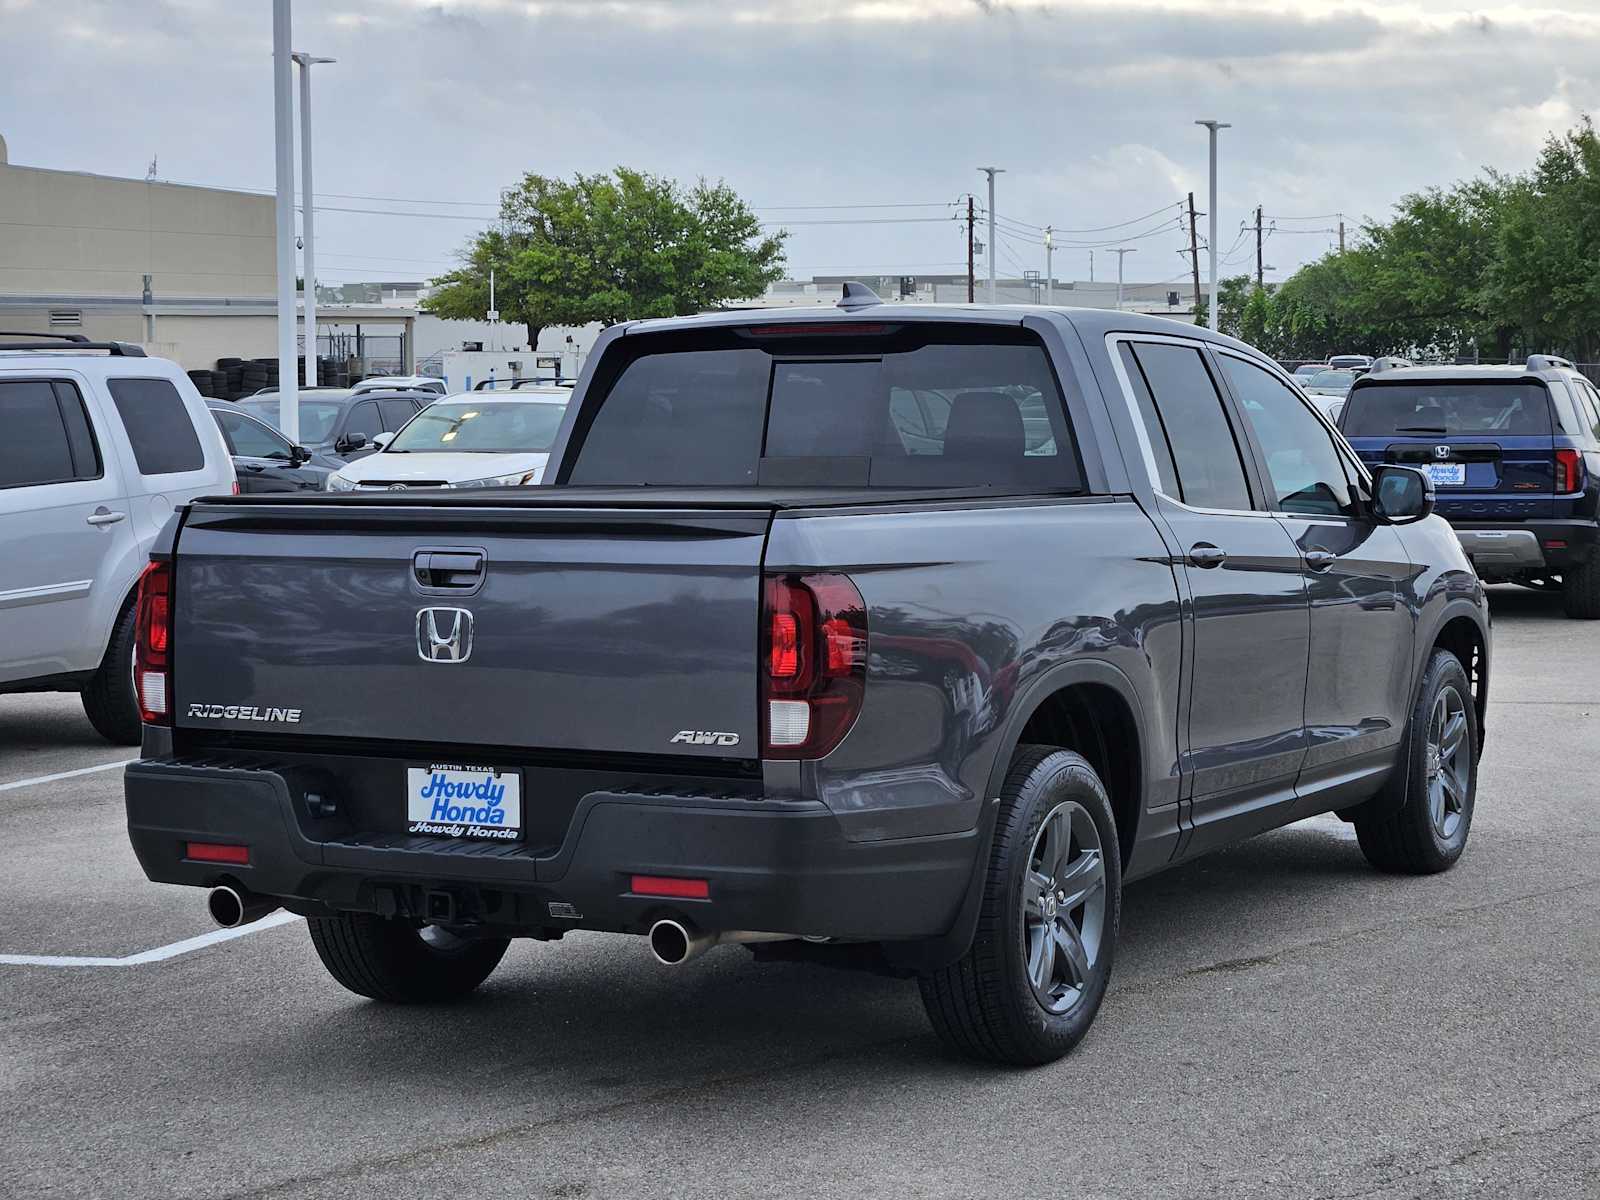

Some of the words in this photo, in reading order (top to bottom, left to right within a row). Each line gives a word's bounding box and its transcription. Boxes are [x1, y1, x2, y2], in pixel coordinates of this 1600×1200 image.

[1427, 465, 1460, 476] Howdy
[187, 703, 302, 723] RIDGELINE
[669, 730, 740, 746] AWD
[430, 763, 462, 771] AUSTIN
[465, 765, 495, 773] TEXAS
[420, 773, 505, 807] Howdy
[430, 797, 505, 825] Honda
[408, 821, 466, 837] Howdy
[466, 825, 519, 839] Honda
